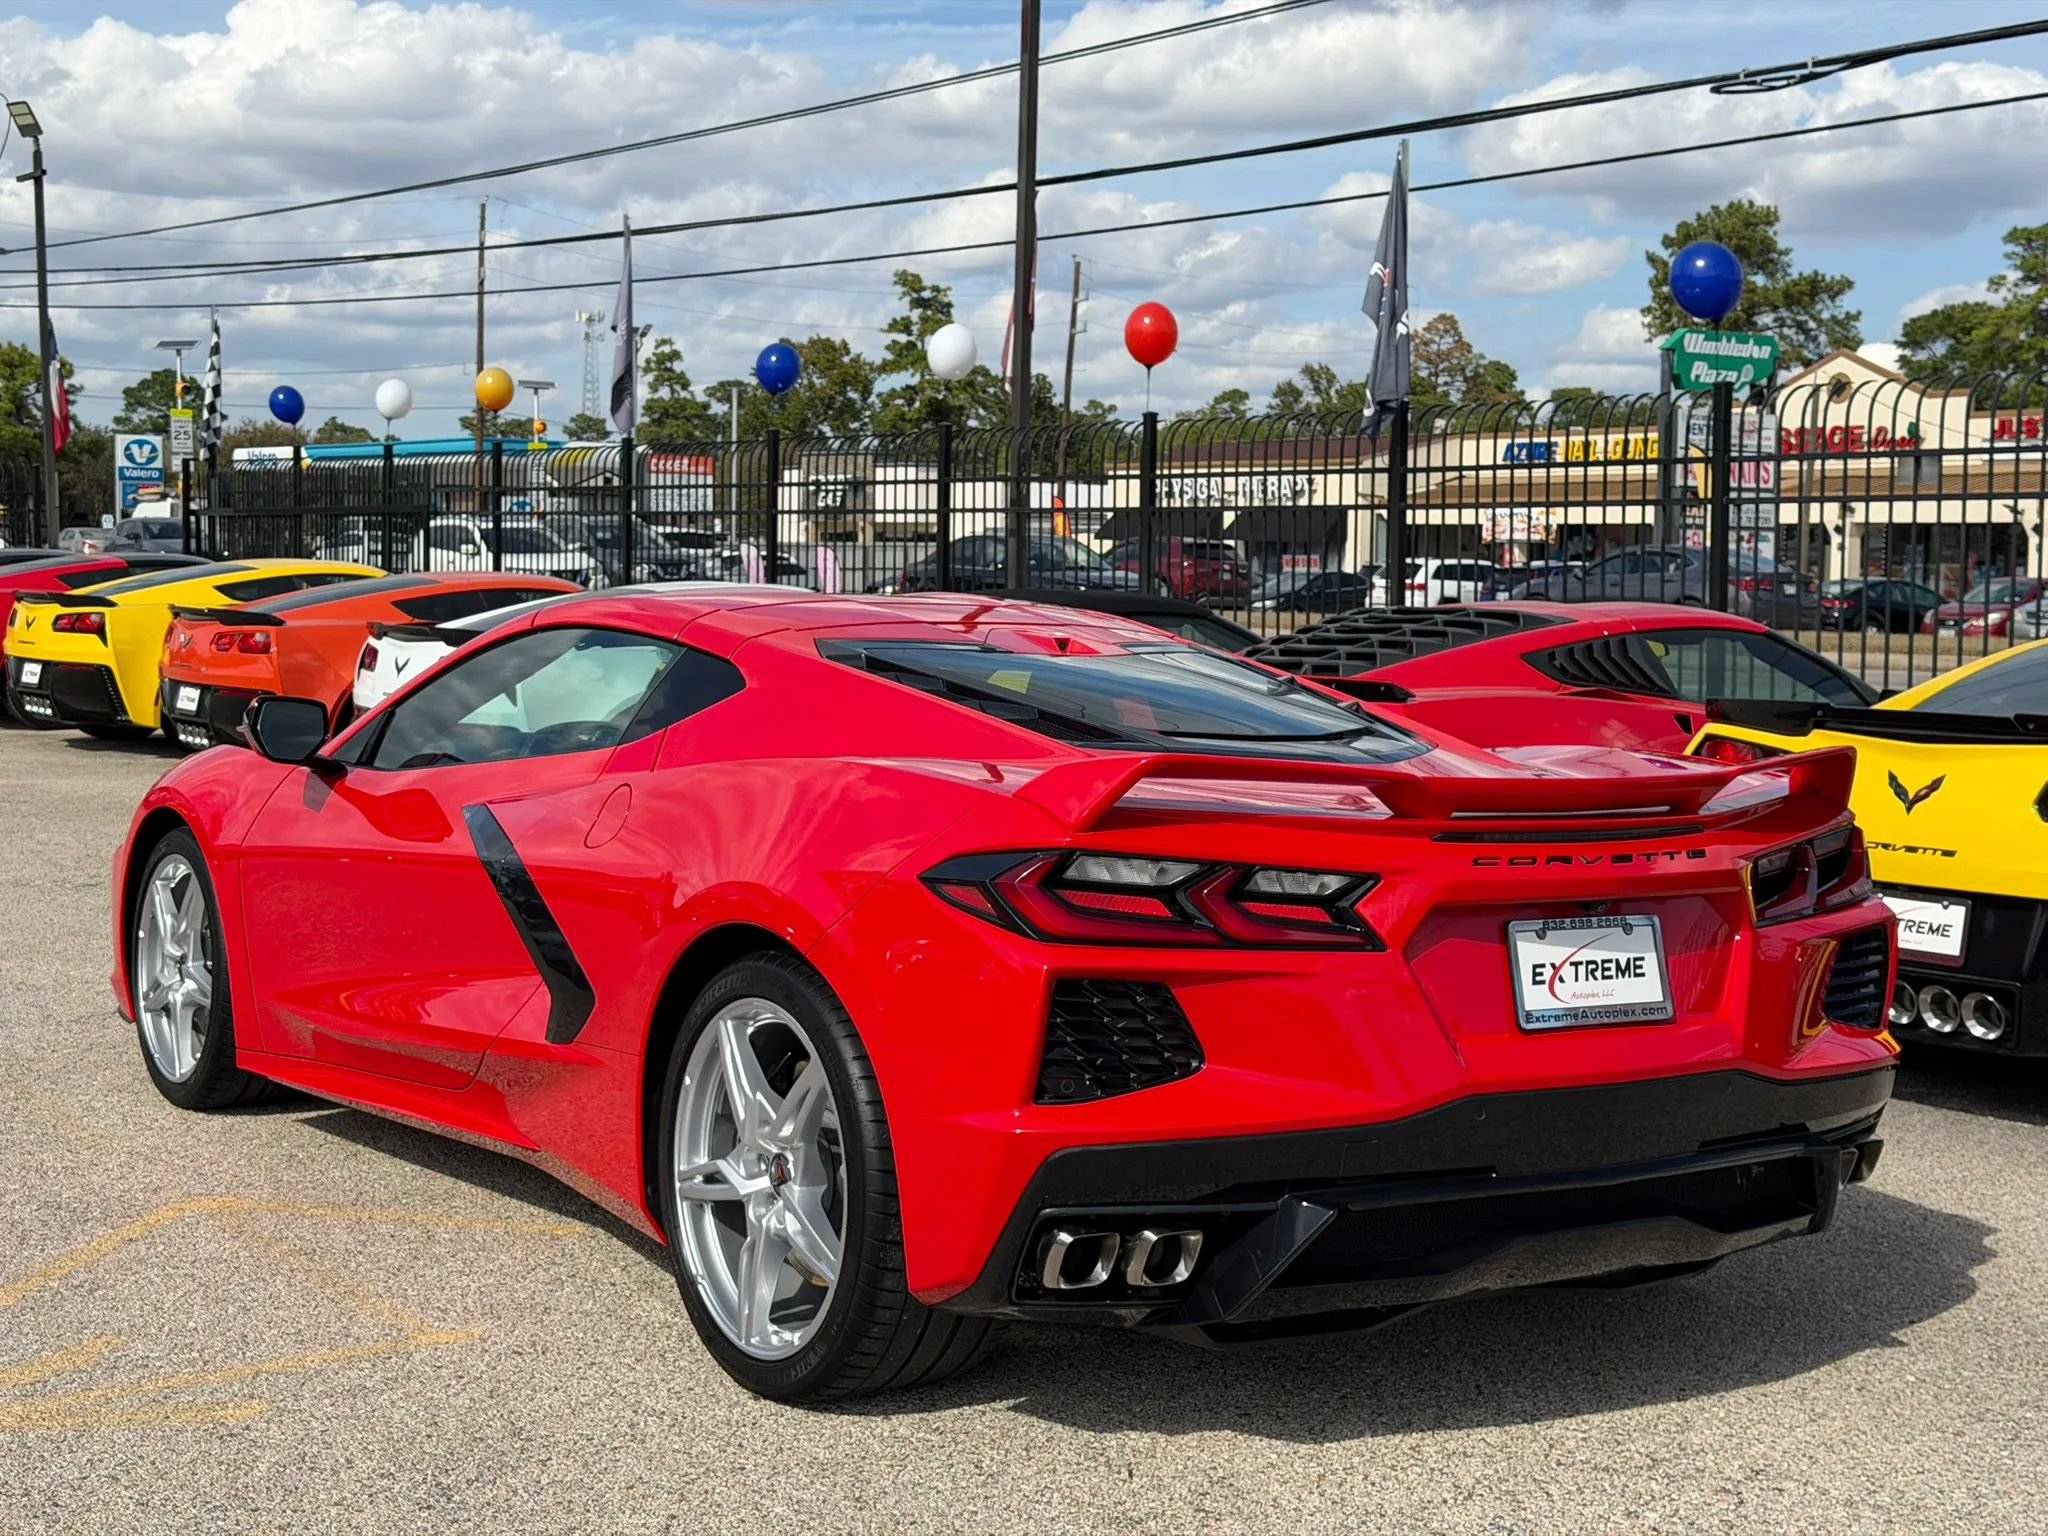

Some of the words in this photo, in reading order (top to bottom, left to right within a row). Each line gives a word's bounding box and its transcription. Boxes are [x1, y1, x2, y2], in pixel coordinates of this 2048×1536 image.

[1683, 332, 1772, 359] Wimbledon
[1690, 361, 1739, 383] Plaza
[174, 430, 191, 441] 25
[1780, 426, 1865, 456] SSAGE
[123, 468, 160, 479] Valero
[1471, 849, 1706, 867] CORVETTE
[1865, 841, 1958, 858] ORVETTE
[1896, 918, 1953, 938] REME
[1532, 956, 1646, 986] EXTREME
[1525, 1006, 1669, 1024] ExtremeAutoplex.com
